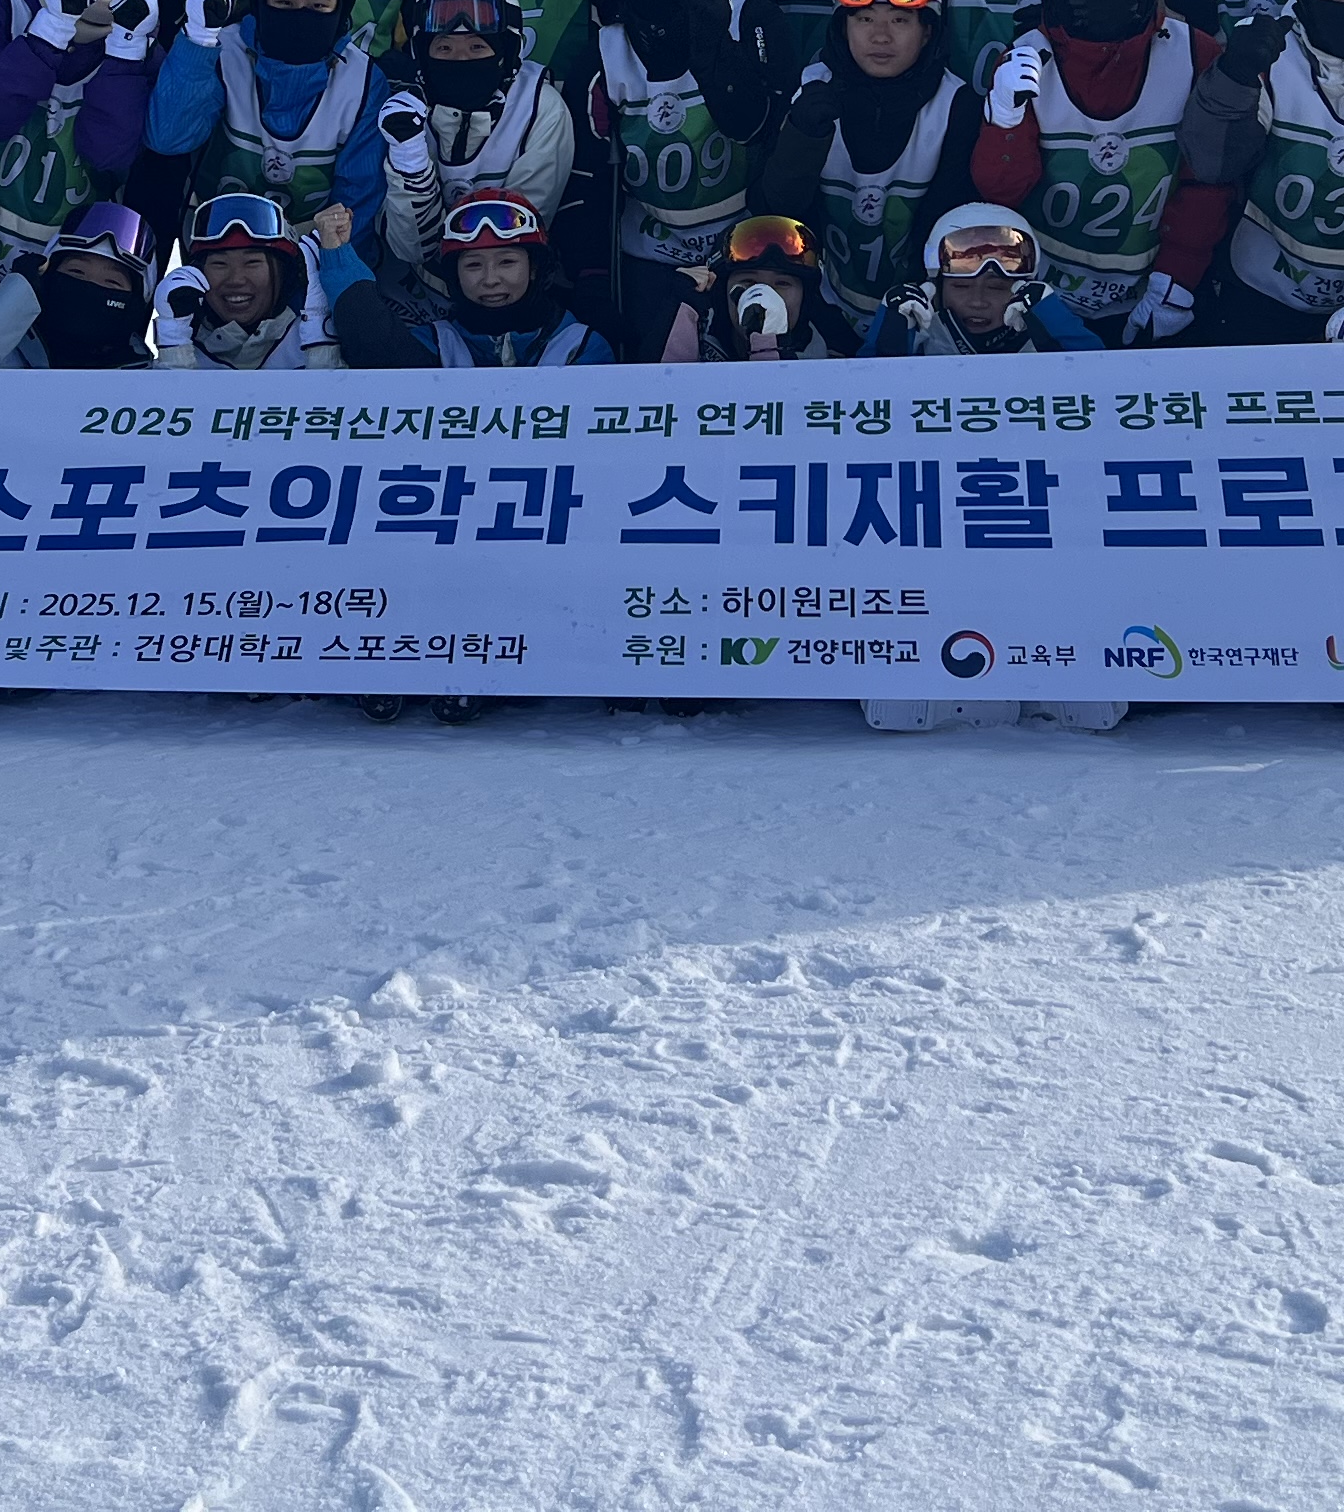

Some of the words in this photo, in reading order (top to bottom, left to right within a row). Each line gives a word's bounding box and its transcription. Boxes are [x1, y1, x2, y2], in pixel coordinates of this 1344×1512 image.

[624, 130, 732, 193] 009
[1042, 174, 1173, 237] 024
[80, 407, 194, 436] 2025
[211, 405, 570, 440] 대학혁신지원사업
[588, 404, 678, 437] 교과
[697, 402, 784, 436] 연계
[804, 399, 892, 436] 학생
[910, 395, 1096, 433] 전공역량
[1115, 391, 1207, 431] 강화
[620, 458, 1059, 549] 스키재활
[39, 593, 166, 617] 2025.12.
[184, 588, 388, 619] 15.(월)~18(목)
[722, 587, 930, 619] 하이원리조트
[134, 634, 303, 664] 건양대학교
[319, 634, 528, 665] 스포츠의학과
[622, 635, 686, 666] 후원
[788, 639, 921, 666] 건양대학교
[1007, 644, 1077, 667] 교육부
[1104, 647, 1166, 668] NRF
[1188, 647, 1300, 667] 한국연구재단
